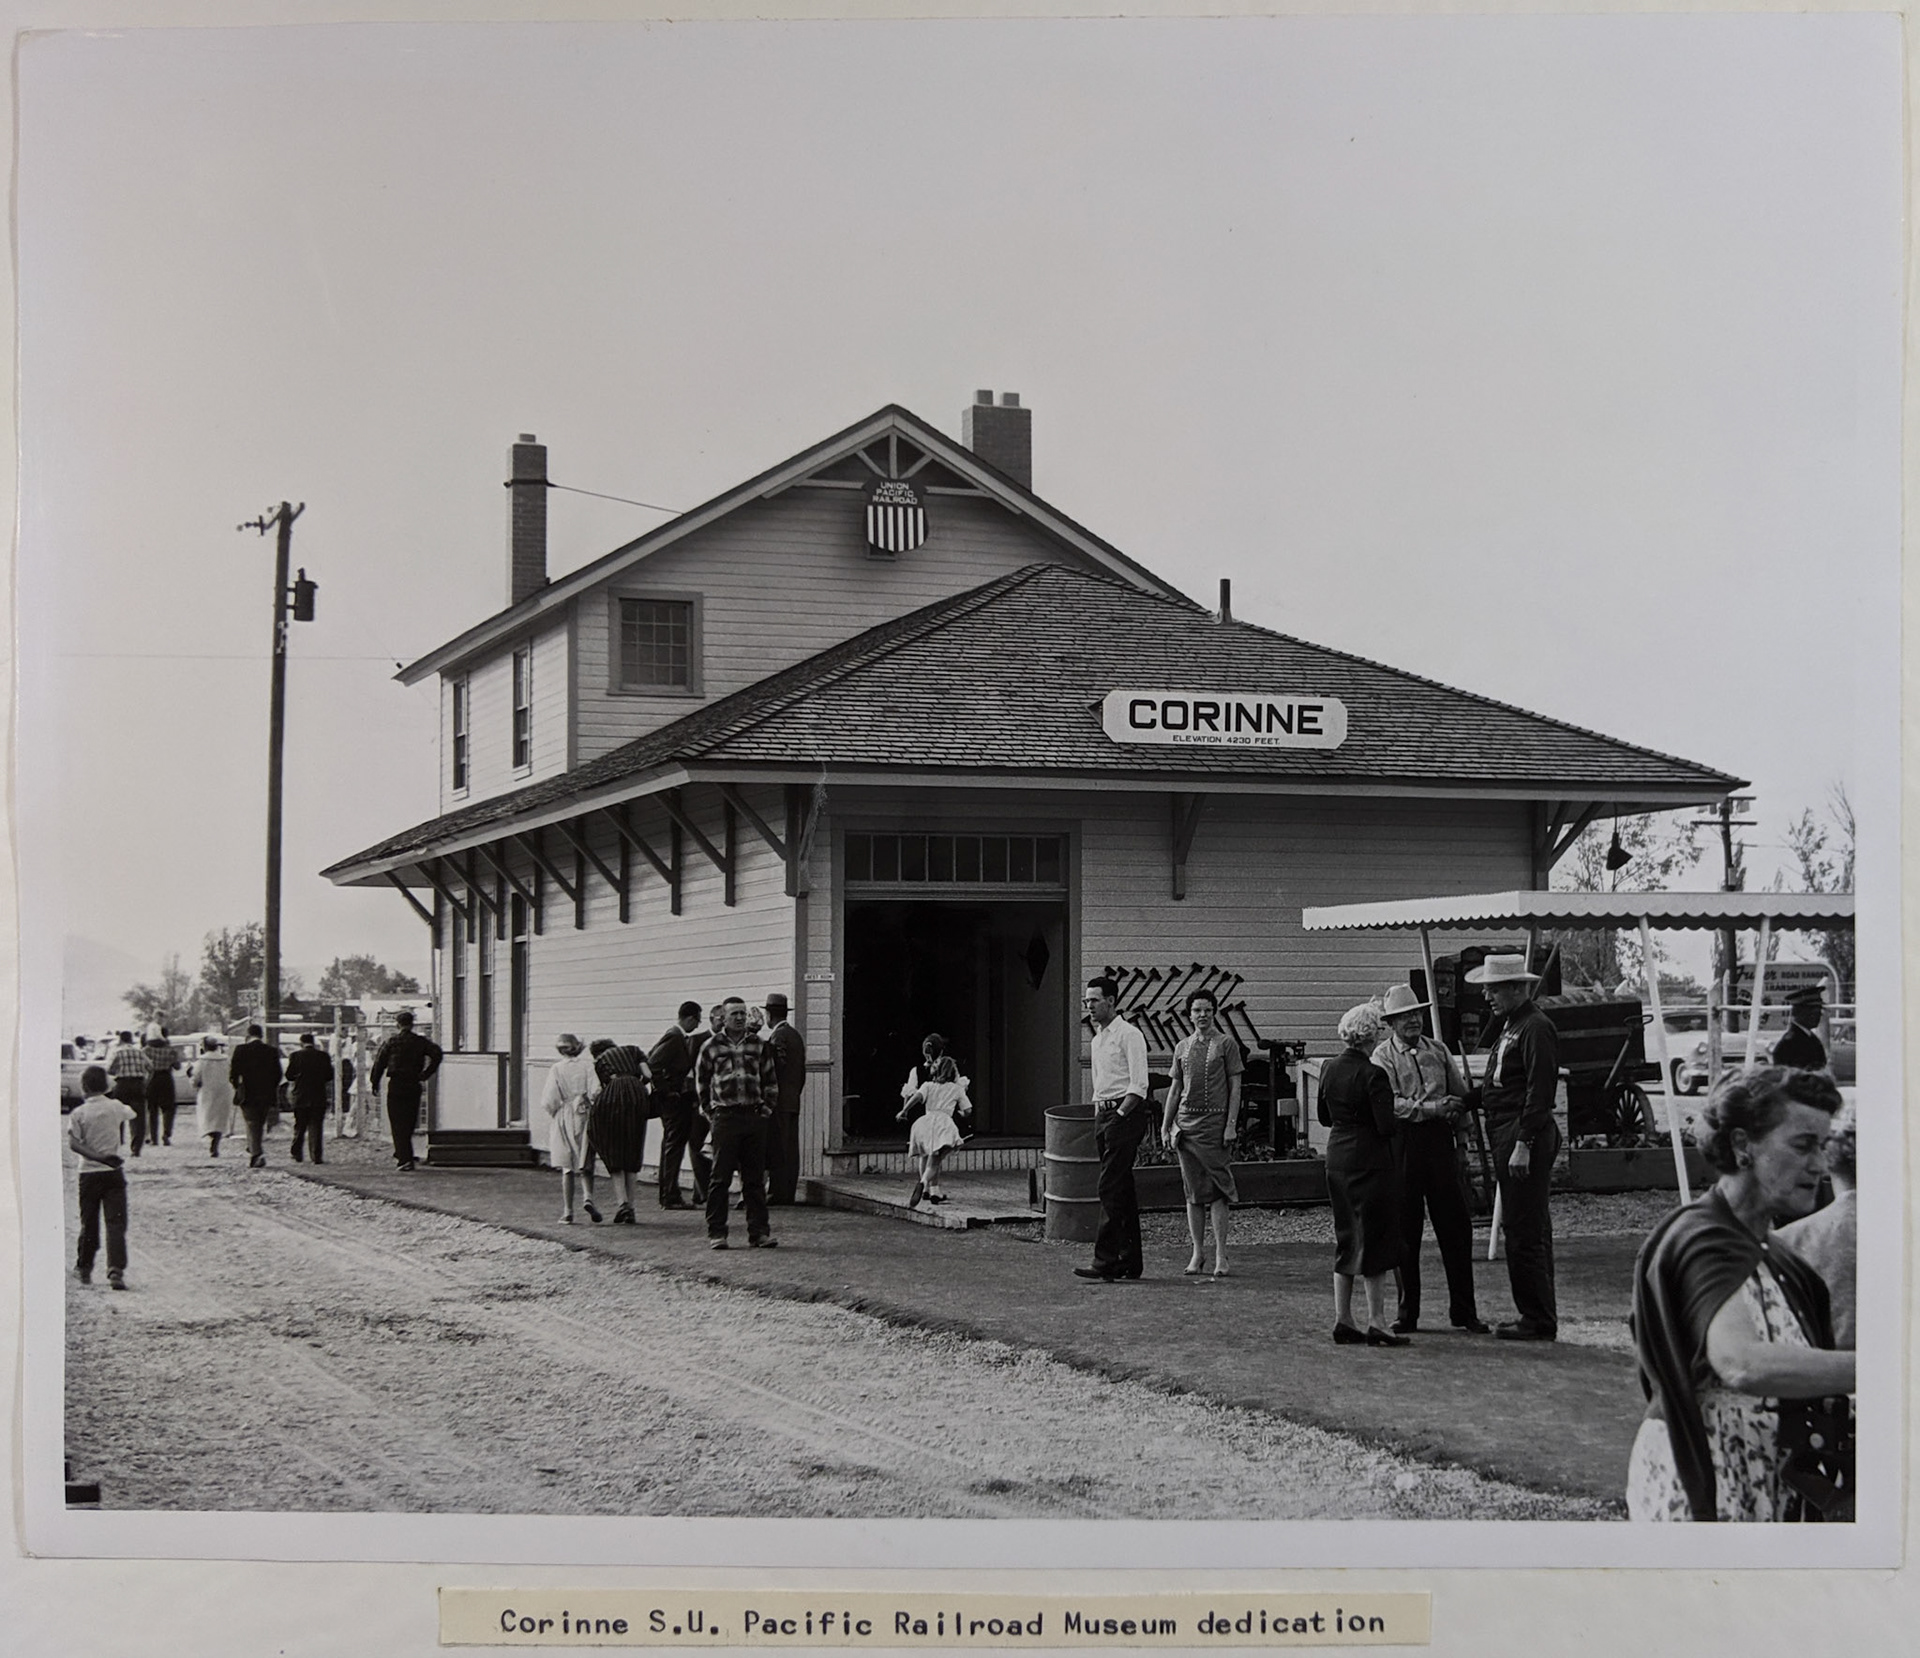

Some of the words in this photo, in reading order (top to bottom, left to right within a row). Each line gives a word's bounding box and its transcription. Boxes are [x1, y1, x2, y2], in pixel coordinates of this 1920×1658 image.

[880, 481, 909, 490] UNION
[876, 488, 915, 498] PACIFIC
[872, 495, 918, 505] RAILROAD
[1129, 699, 1324, 735] CORINNE
[1172, 734, 1222, 744] ELEVATION
[1226, 736, 1252, 744] 4230
